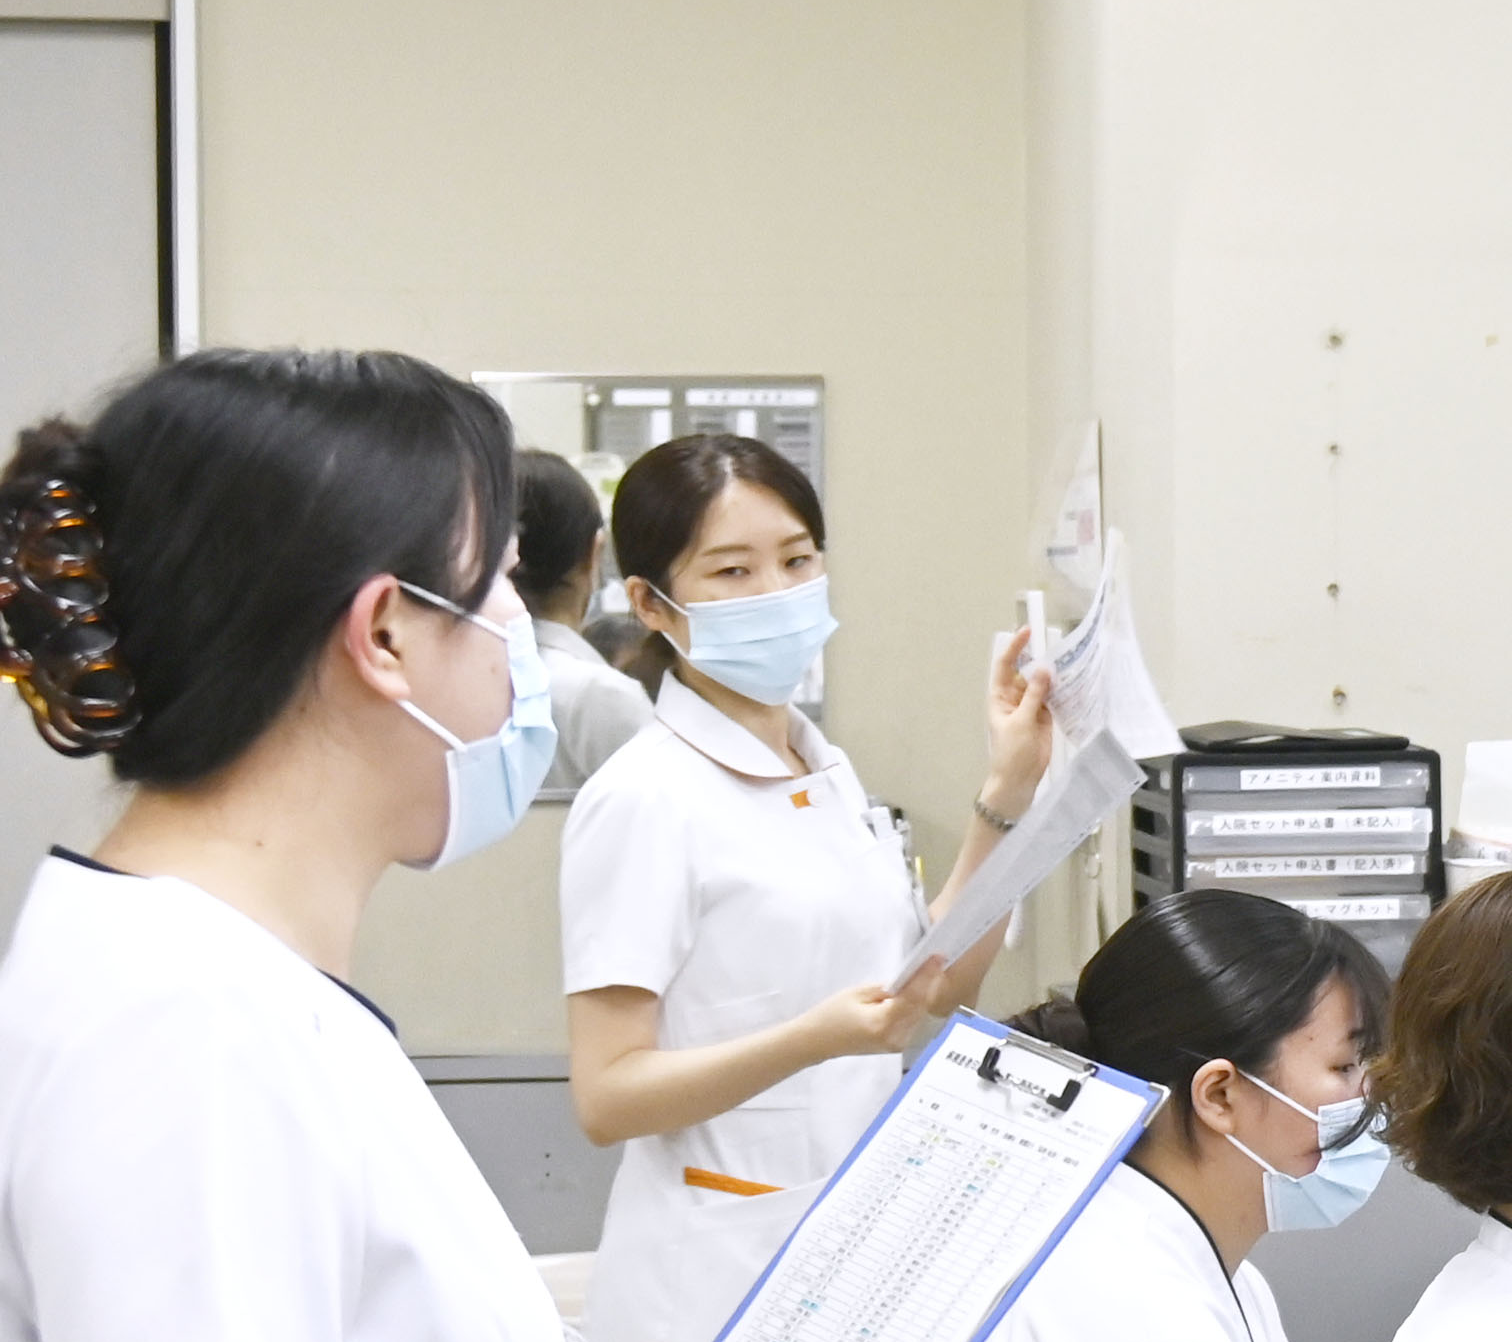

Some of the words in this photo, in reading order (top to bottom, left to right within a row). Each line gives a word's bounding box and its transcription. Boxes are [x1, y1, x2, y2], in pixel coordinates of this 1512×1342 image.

[1248, 770, 1376, 786] アメニティ案内資料
